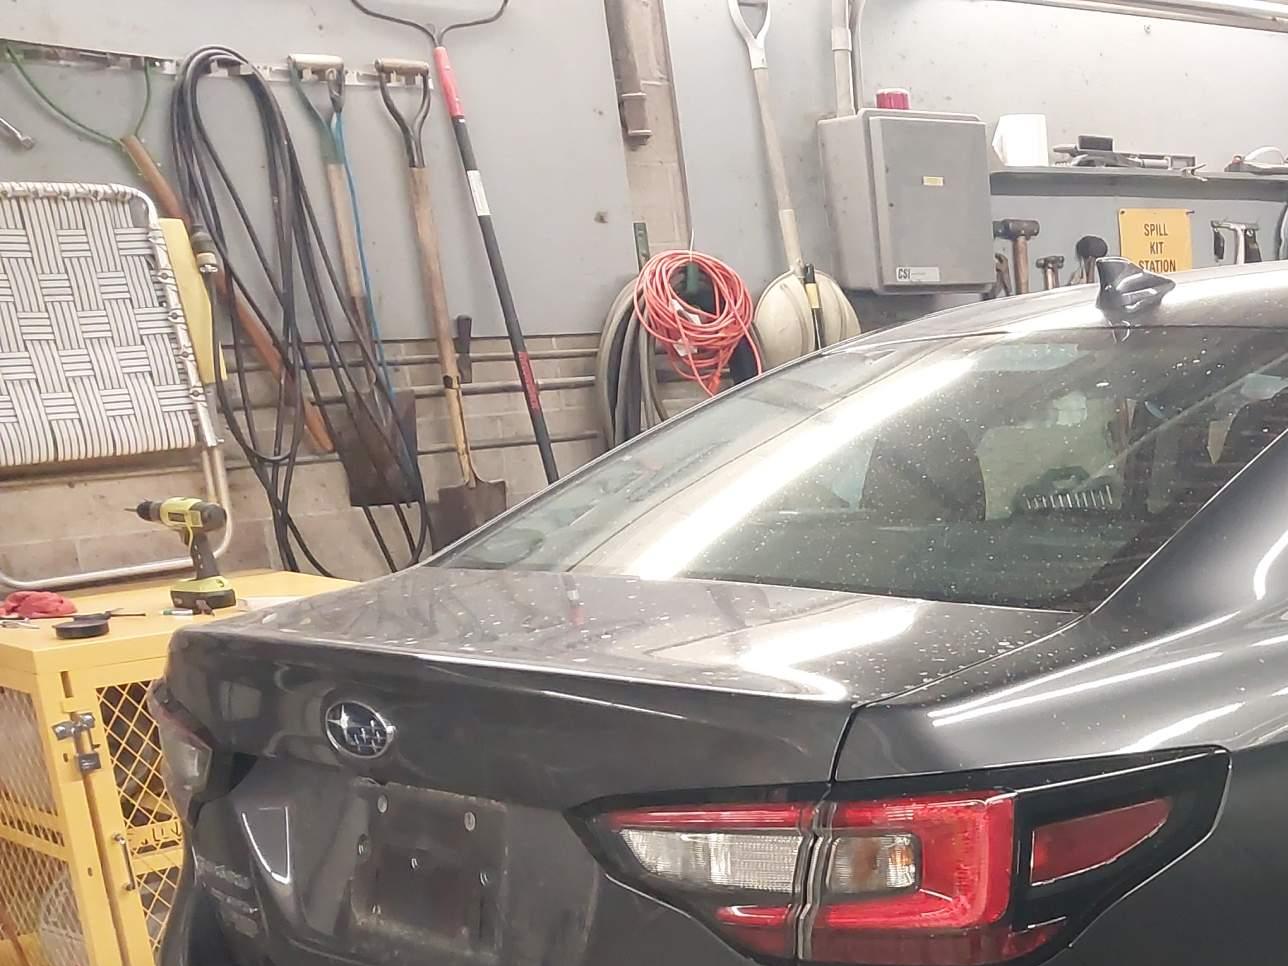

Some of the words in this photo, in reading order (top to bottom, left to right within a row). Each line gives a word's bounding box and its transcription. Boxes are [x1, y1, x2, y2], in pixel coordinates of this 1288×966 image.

[1143, 223, 1168, 237] SPILL
[1150, 241, 1164, 255] KIT
[1139, 259, 1177, 273] STATION
